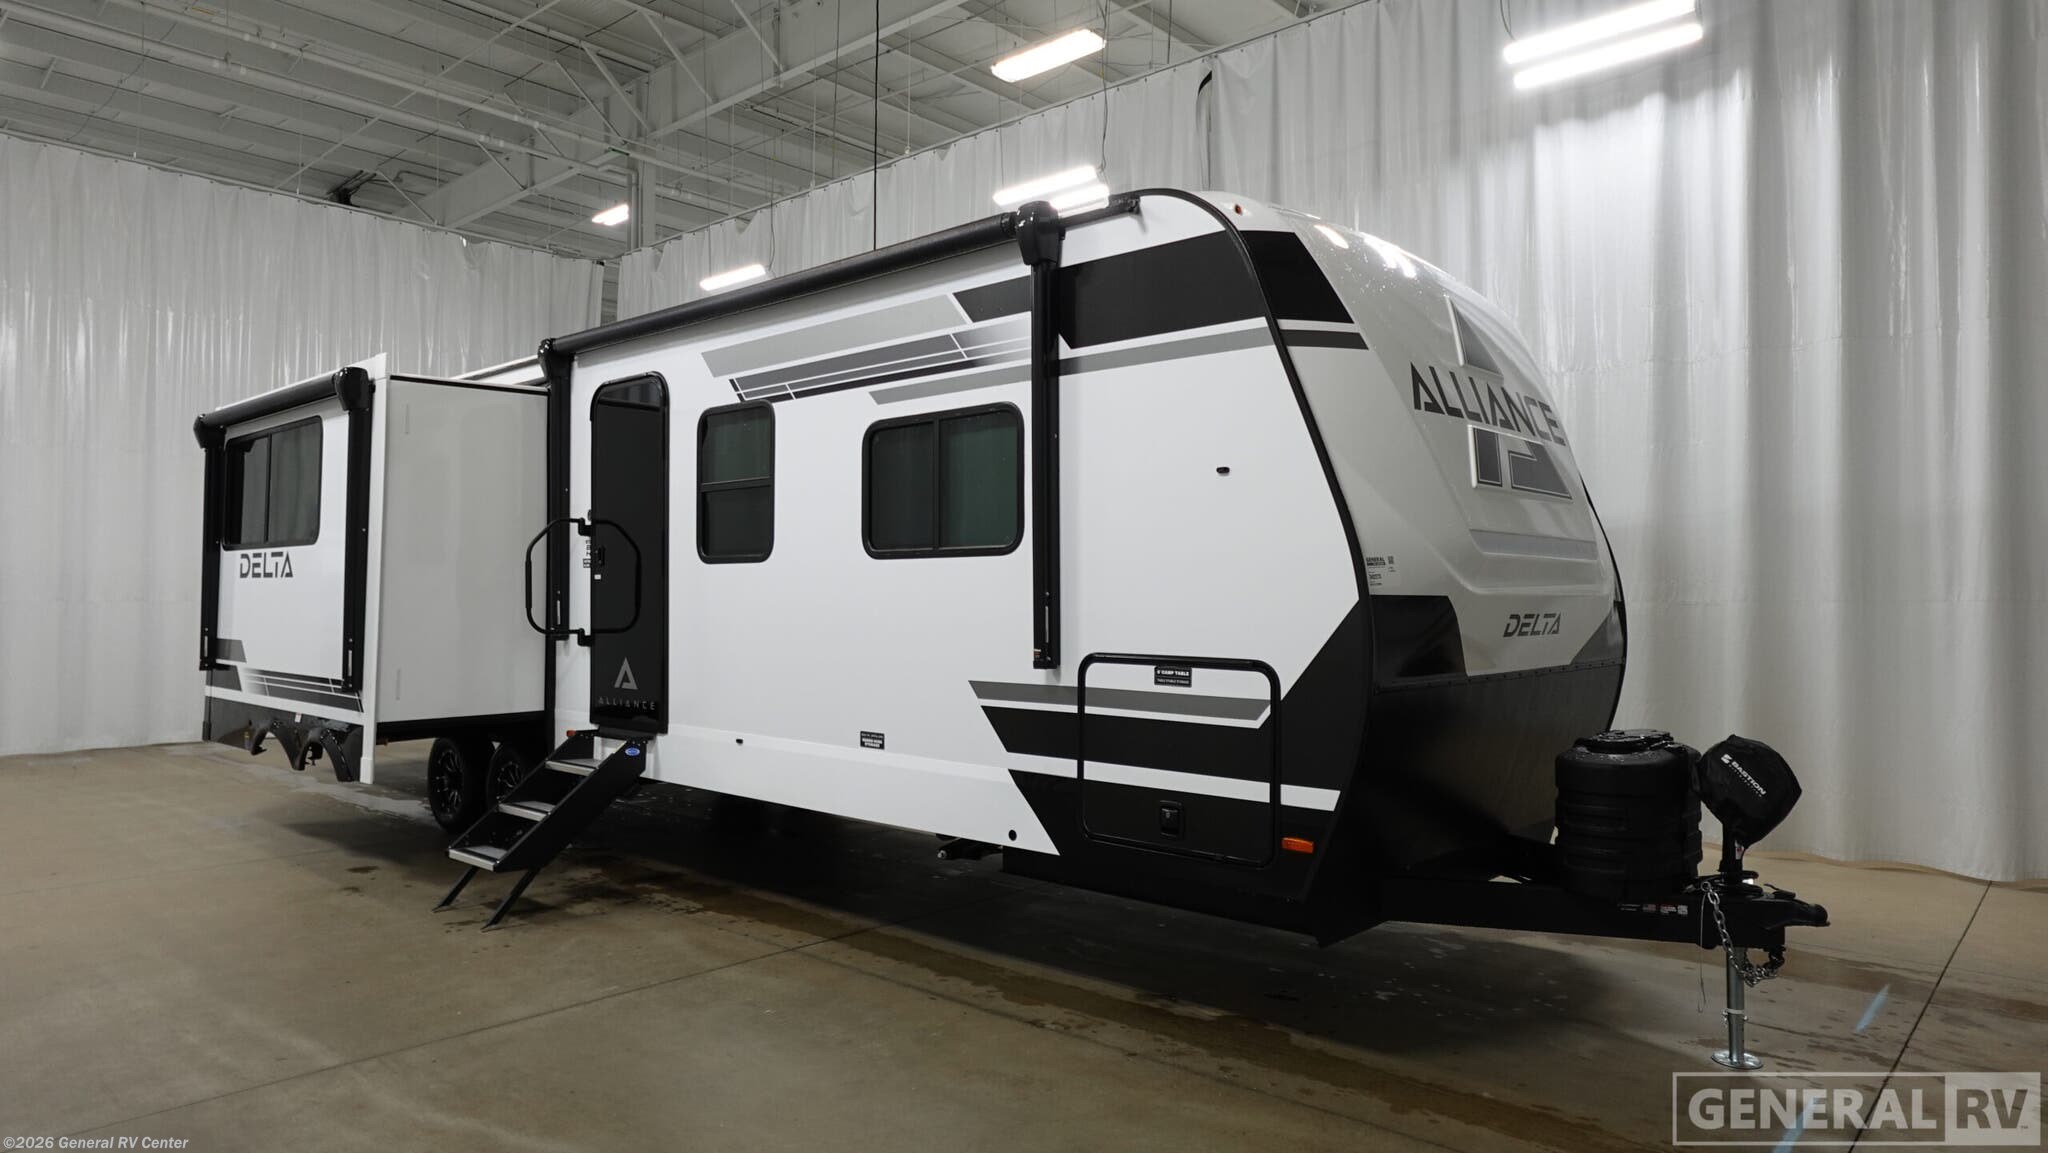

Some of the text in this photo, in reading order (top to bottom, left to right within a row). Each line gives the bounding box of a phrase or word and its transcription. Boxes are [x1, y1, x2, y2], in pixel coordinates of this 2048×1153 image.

[1410, 361, 1567, 447] ALLIANCE
[239, 551, 294, 579] DELTA
[1503, 612, 1562, 638] DELTA
[598, 696, 656, 711] ALLIANCE
[1731, 761, 1767, 795] BASTION
